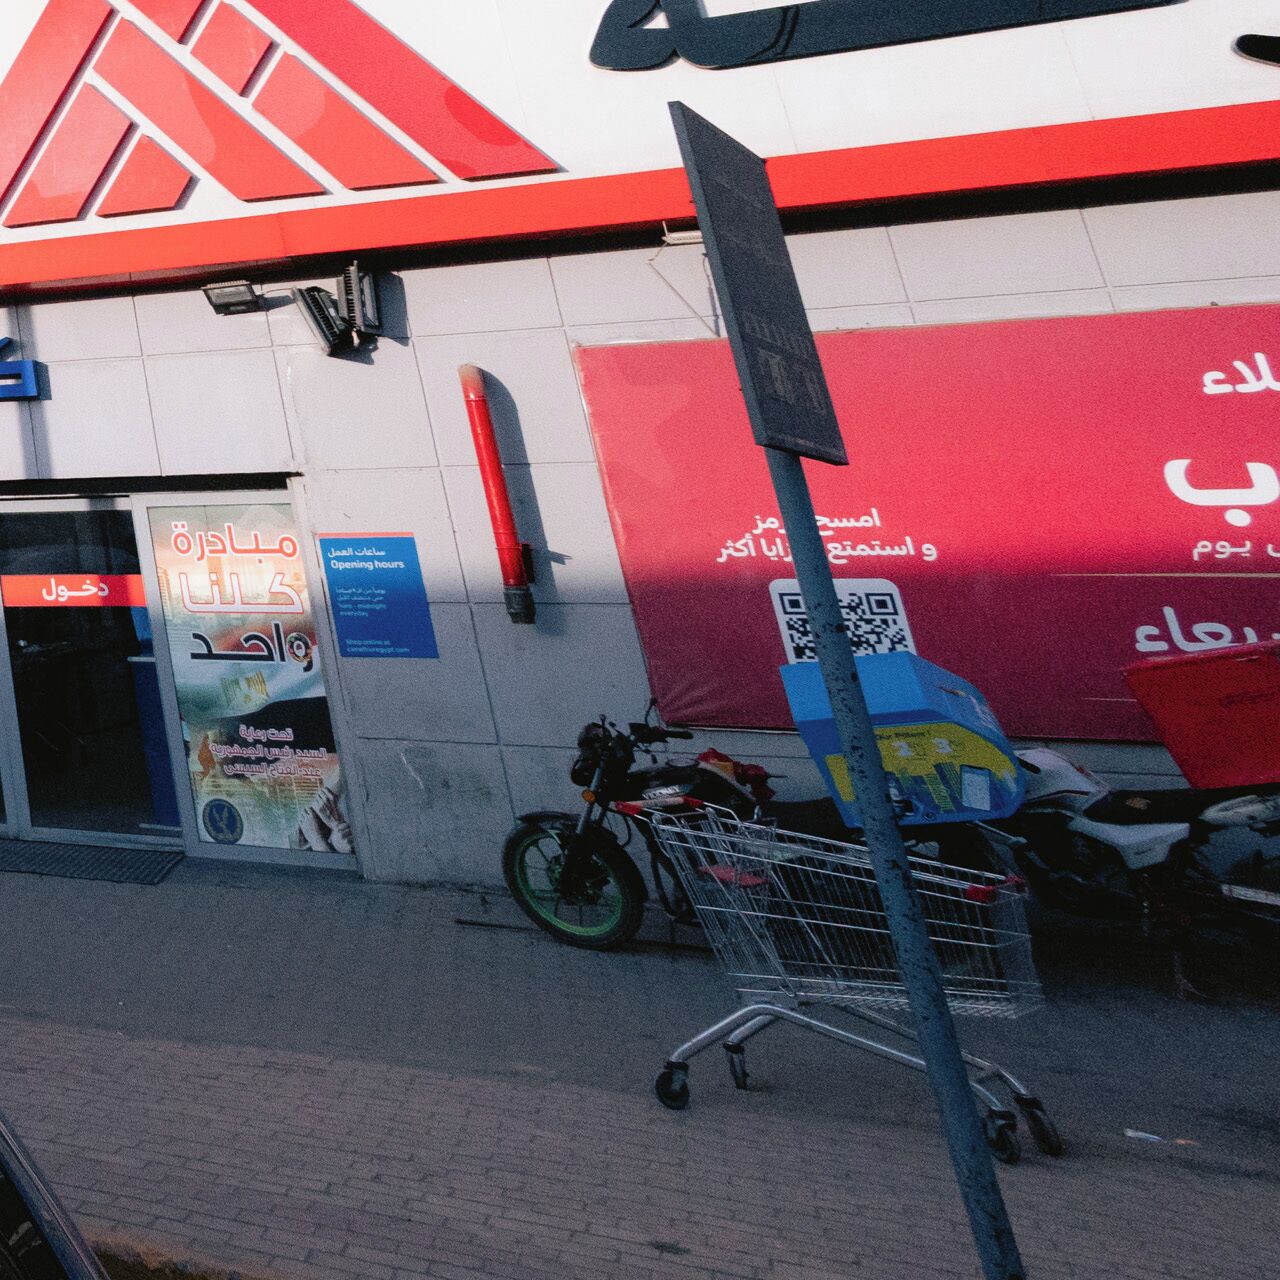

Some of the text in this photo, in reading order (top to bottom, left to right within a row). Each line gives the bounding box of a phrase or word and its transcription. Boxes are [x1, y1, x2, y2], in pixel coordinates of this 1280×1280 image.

[171, 521, 299, 564] مبادرة
[716, 532, 757, 563] أكثر
[827, 536, 916, 564] استمتع
[1192, 538, 1251, 561] يوم
[330, 559, 406, 570] Opening hours
[41, 577, 110, 602] دخول
[178, 571, 305, 615] كلنا
[190, 620, 314, 673] واحد
[267, 727, 294, 741] تحت
